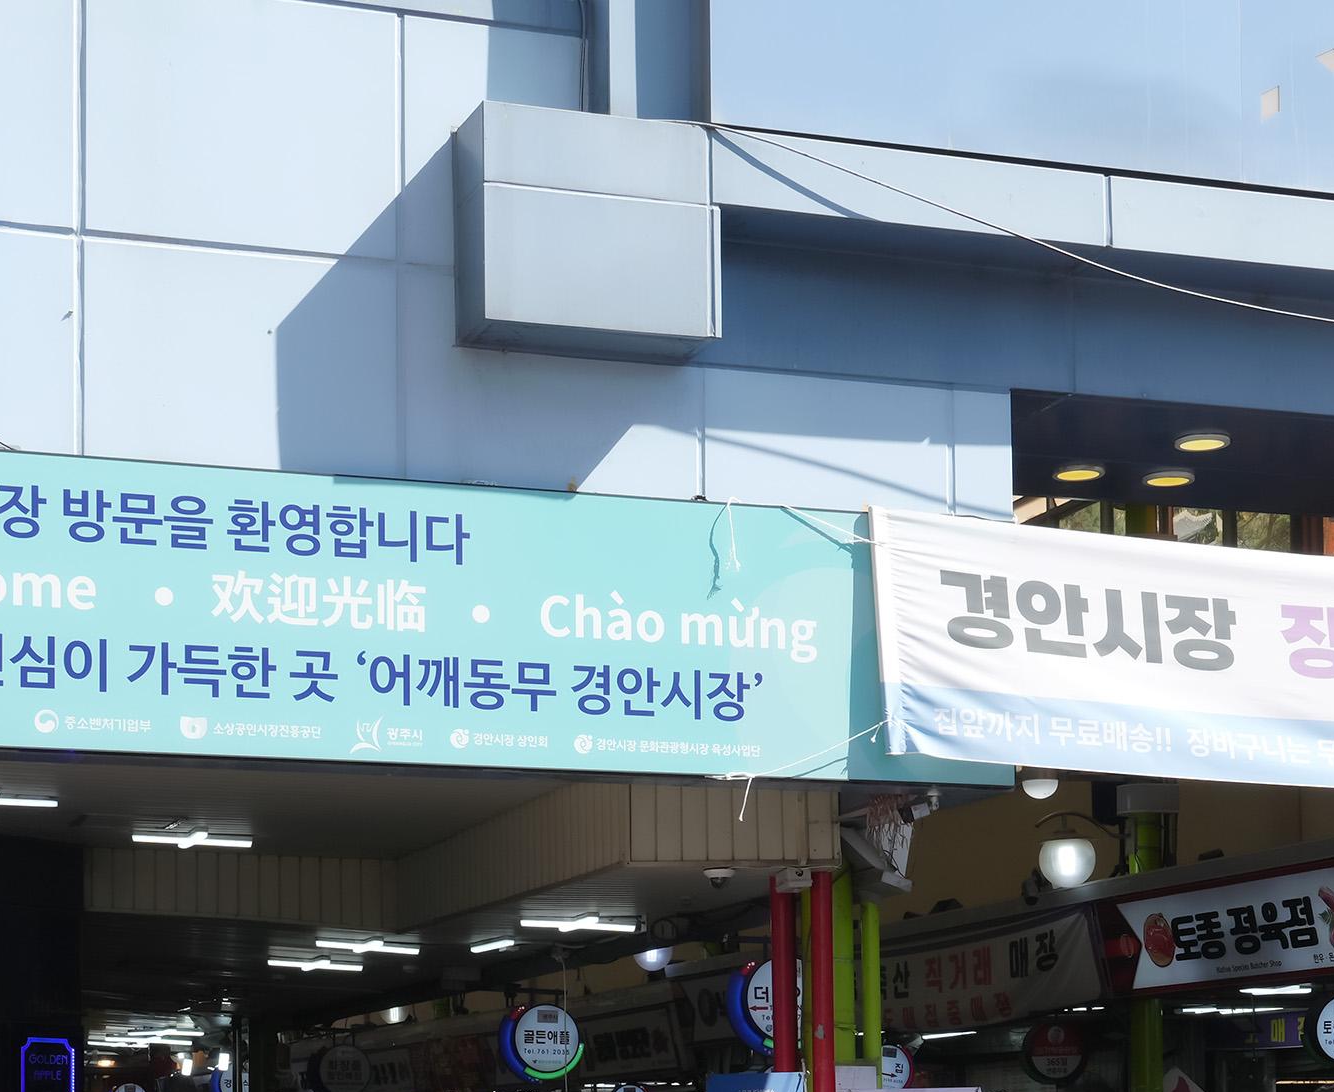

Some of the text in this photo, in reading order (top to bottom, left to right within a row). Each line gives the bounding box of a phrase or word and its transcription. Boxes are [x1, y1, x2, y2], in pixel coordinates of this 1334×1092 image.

[62, 488, 215, 549] 방문을
[226, 499, 471, 566] 환영합니다
[211, 568, 427, 634] 欢迎光临
[539, 588, 818, 664] Chào mừng
[938, 568, 1238, 675] 경안시장
[126, 640, 278, 699] 가득한
[289, 653, 340, 703] 곳
[64, 715, 153, 732] 중소벤처기업부
[387, 726, 423, 741] 광주시
[473, 731, 548, 748] 경안시장 상인회
[595, 737, 637, 753] 경안시장
[932, 706, 1041, 745] 집앞까지
[1048, 713, 1171, 754] 무료배송!!
[1186, 731, 1311, 767] 장바구니는
[1009, 929, 1059, 978] 매장
[524, 1029, 570, 1045] 골든애플
